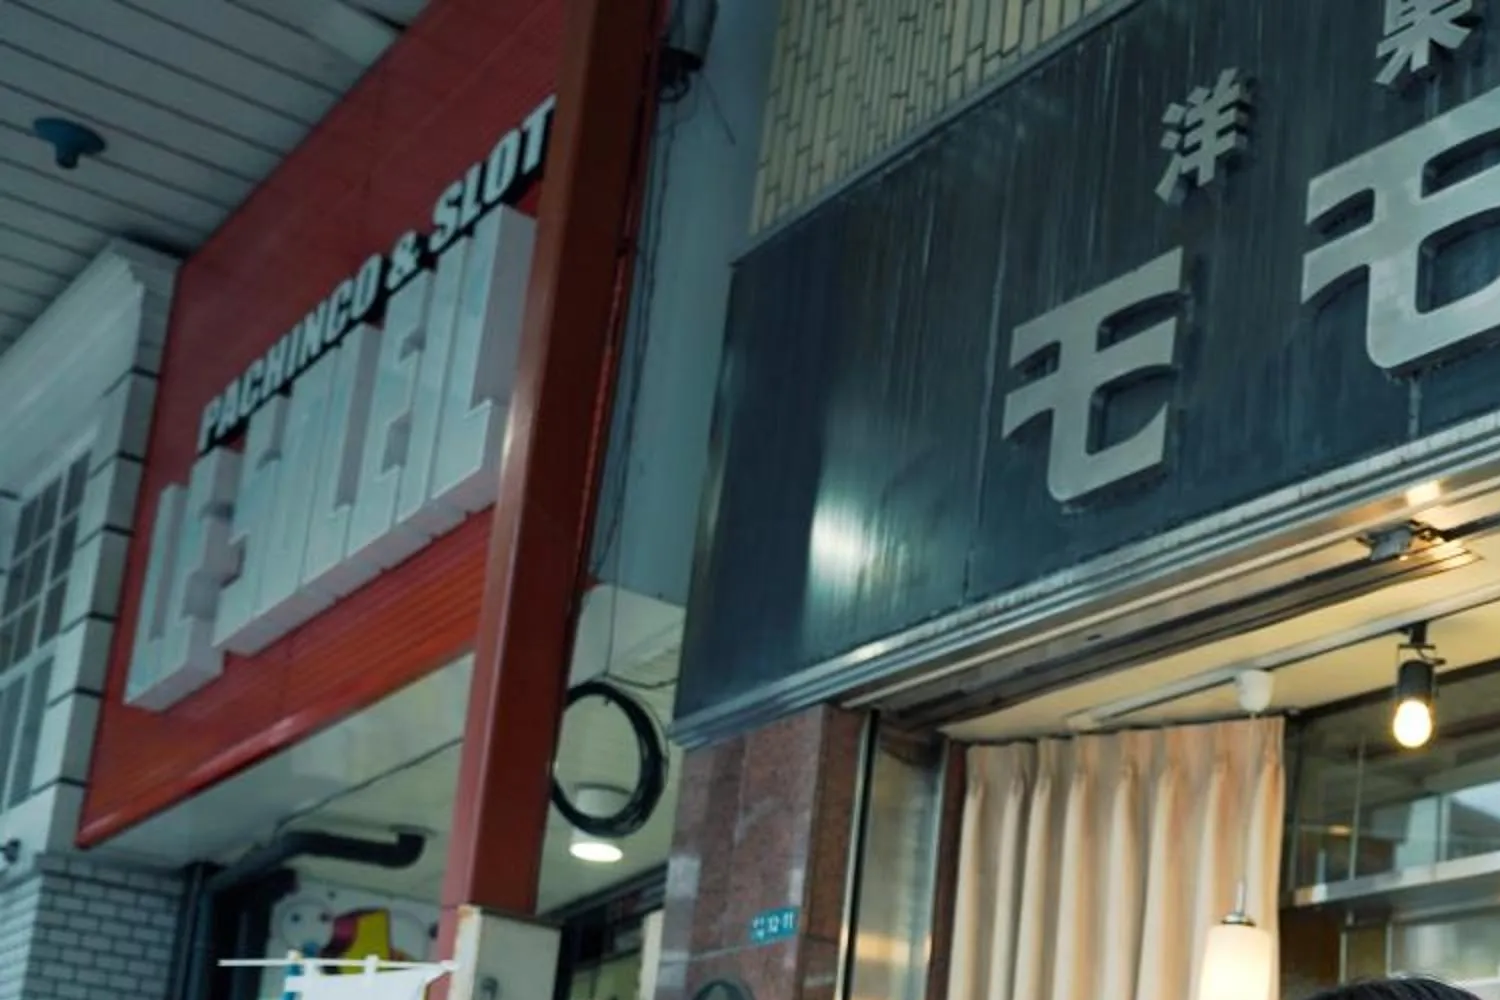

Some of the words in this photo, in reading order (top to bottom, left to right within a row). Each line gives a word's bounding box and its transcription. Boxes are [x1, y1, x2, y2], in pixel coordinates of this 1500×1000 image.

[197, 253, 384, 454] PACHINCO
[386, 230, 426, 290] &
[428, 94, 556, 254] SLOT
